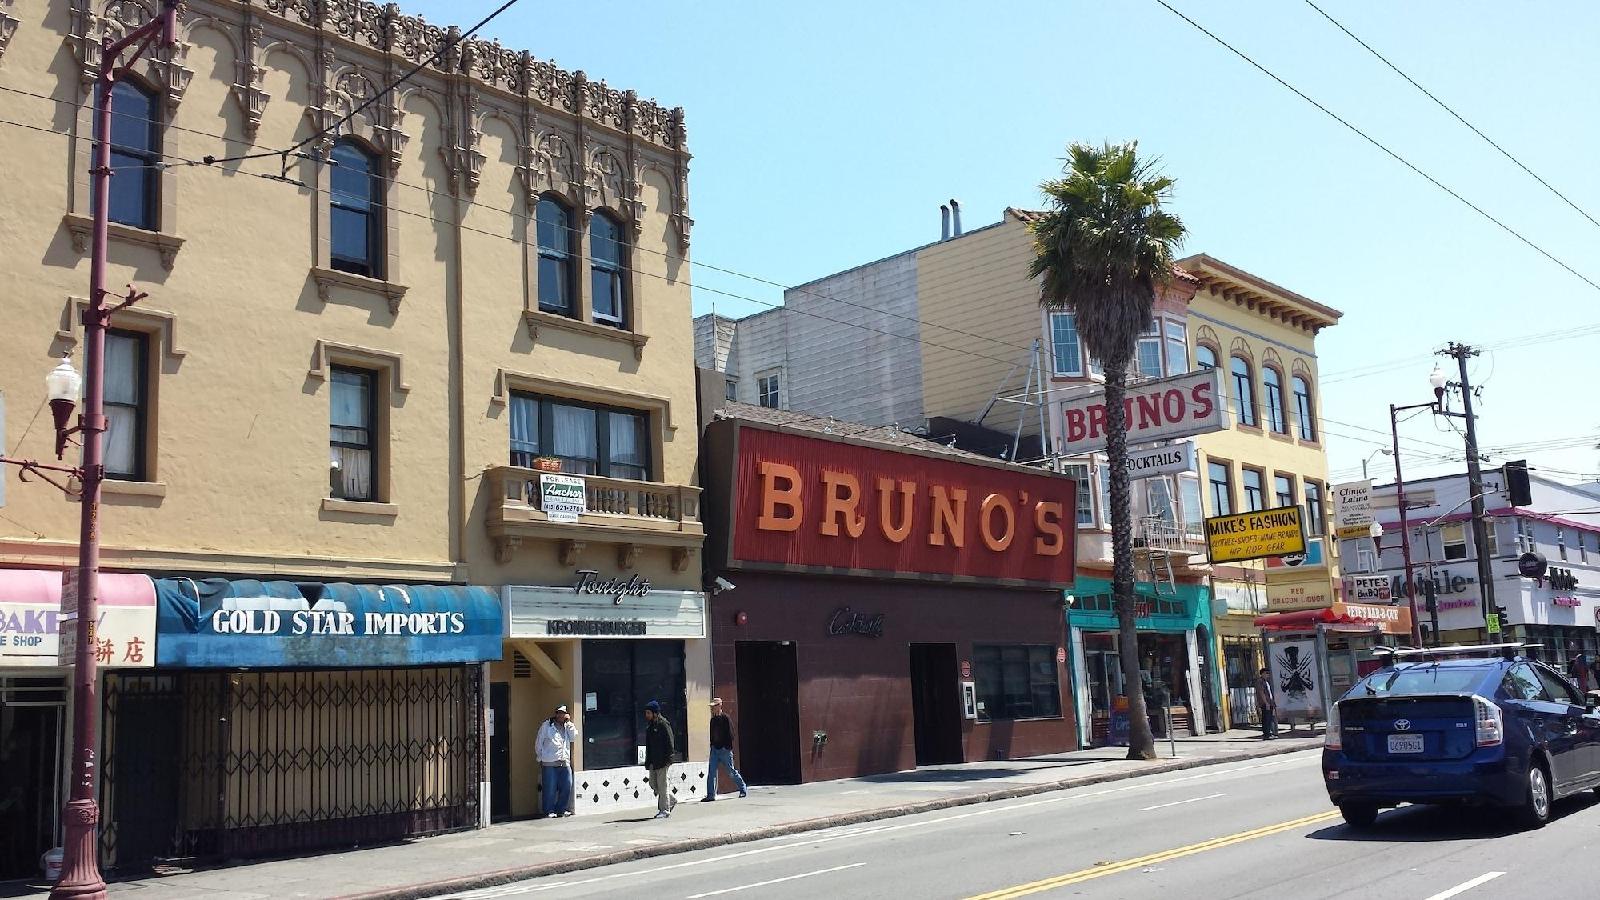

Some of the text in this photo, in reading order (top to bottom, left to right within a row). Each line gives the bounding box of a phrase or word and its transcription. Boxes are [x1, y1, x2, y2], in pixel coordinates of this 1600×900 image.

[1126, 451, 1182, 470] OCKTAILS
[758, 461, 1064, 556] BRUNO'S
[1210, 511, 1297, 536] MIKE'S FASHION
[576, 569, 652, 605] Tonight
[1356, 577, 1389, 588] PETE'S
[213, 608, 465, 636] GOLD STAR IMPORTS
[13, 636, 42, 647] SHOP
